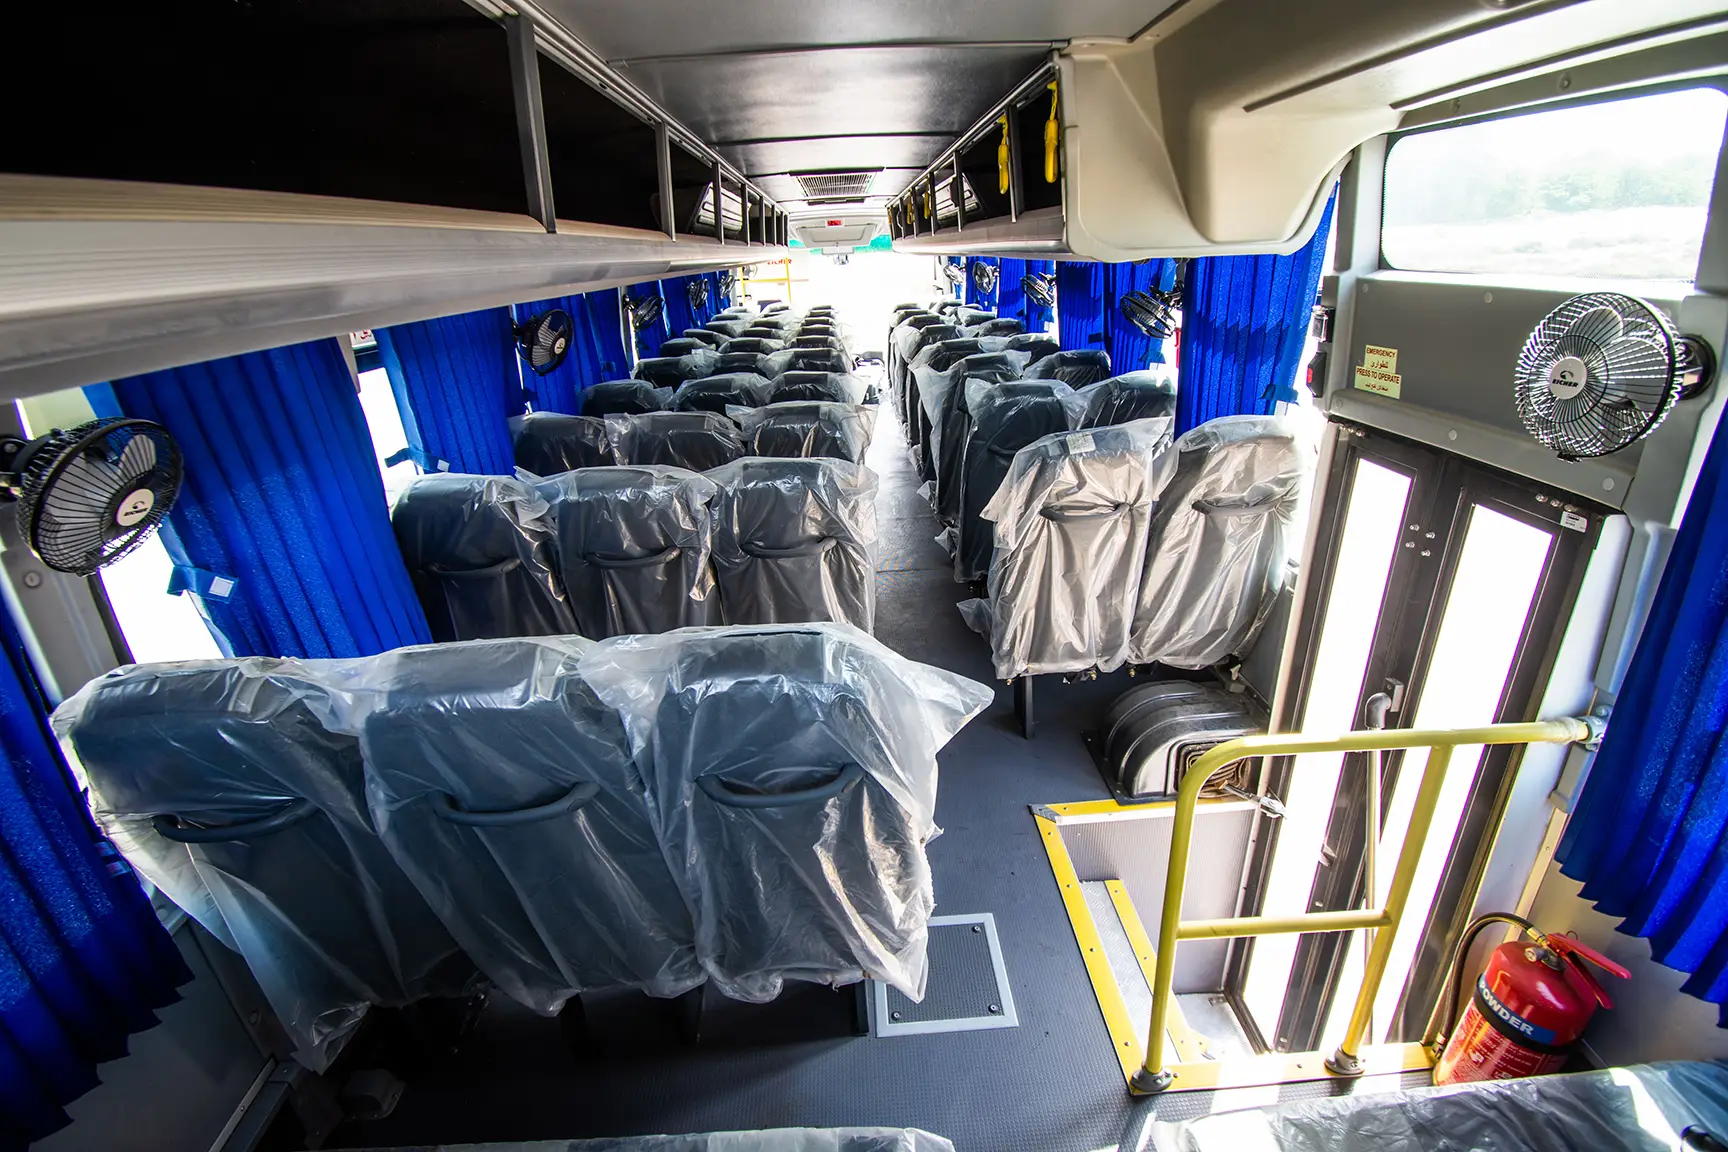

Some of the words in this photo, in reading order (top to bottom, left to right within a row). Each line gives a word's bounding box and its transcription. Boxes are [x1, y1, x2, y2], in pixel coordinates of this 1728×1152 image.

[1366, 347, 1396, 358] EMERGENCY
[1356, 367, 1371, 378] PRESS
[1371, 370, 1378, 379] TO
[1378, 372, 1400, 385] OPERATE
[1552, 379, 1579, 388] EICHER
[1479, 980, 1535, 1036] POWDER
